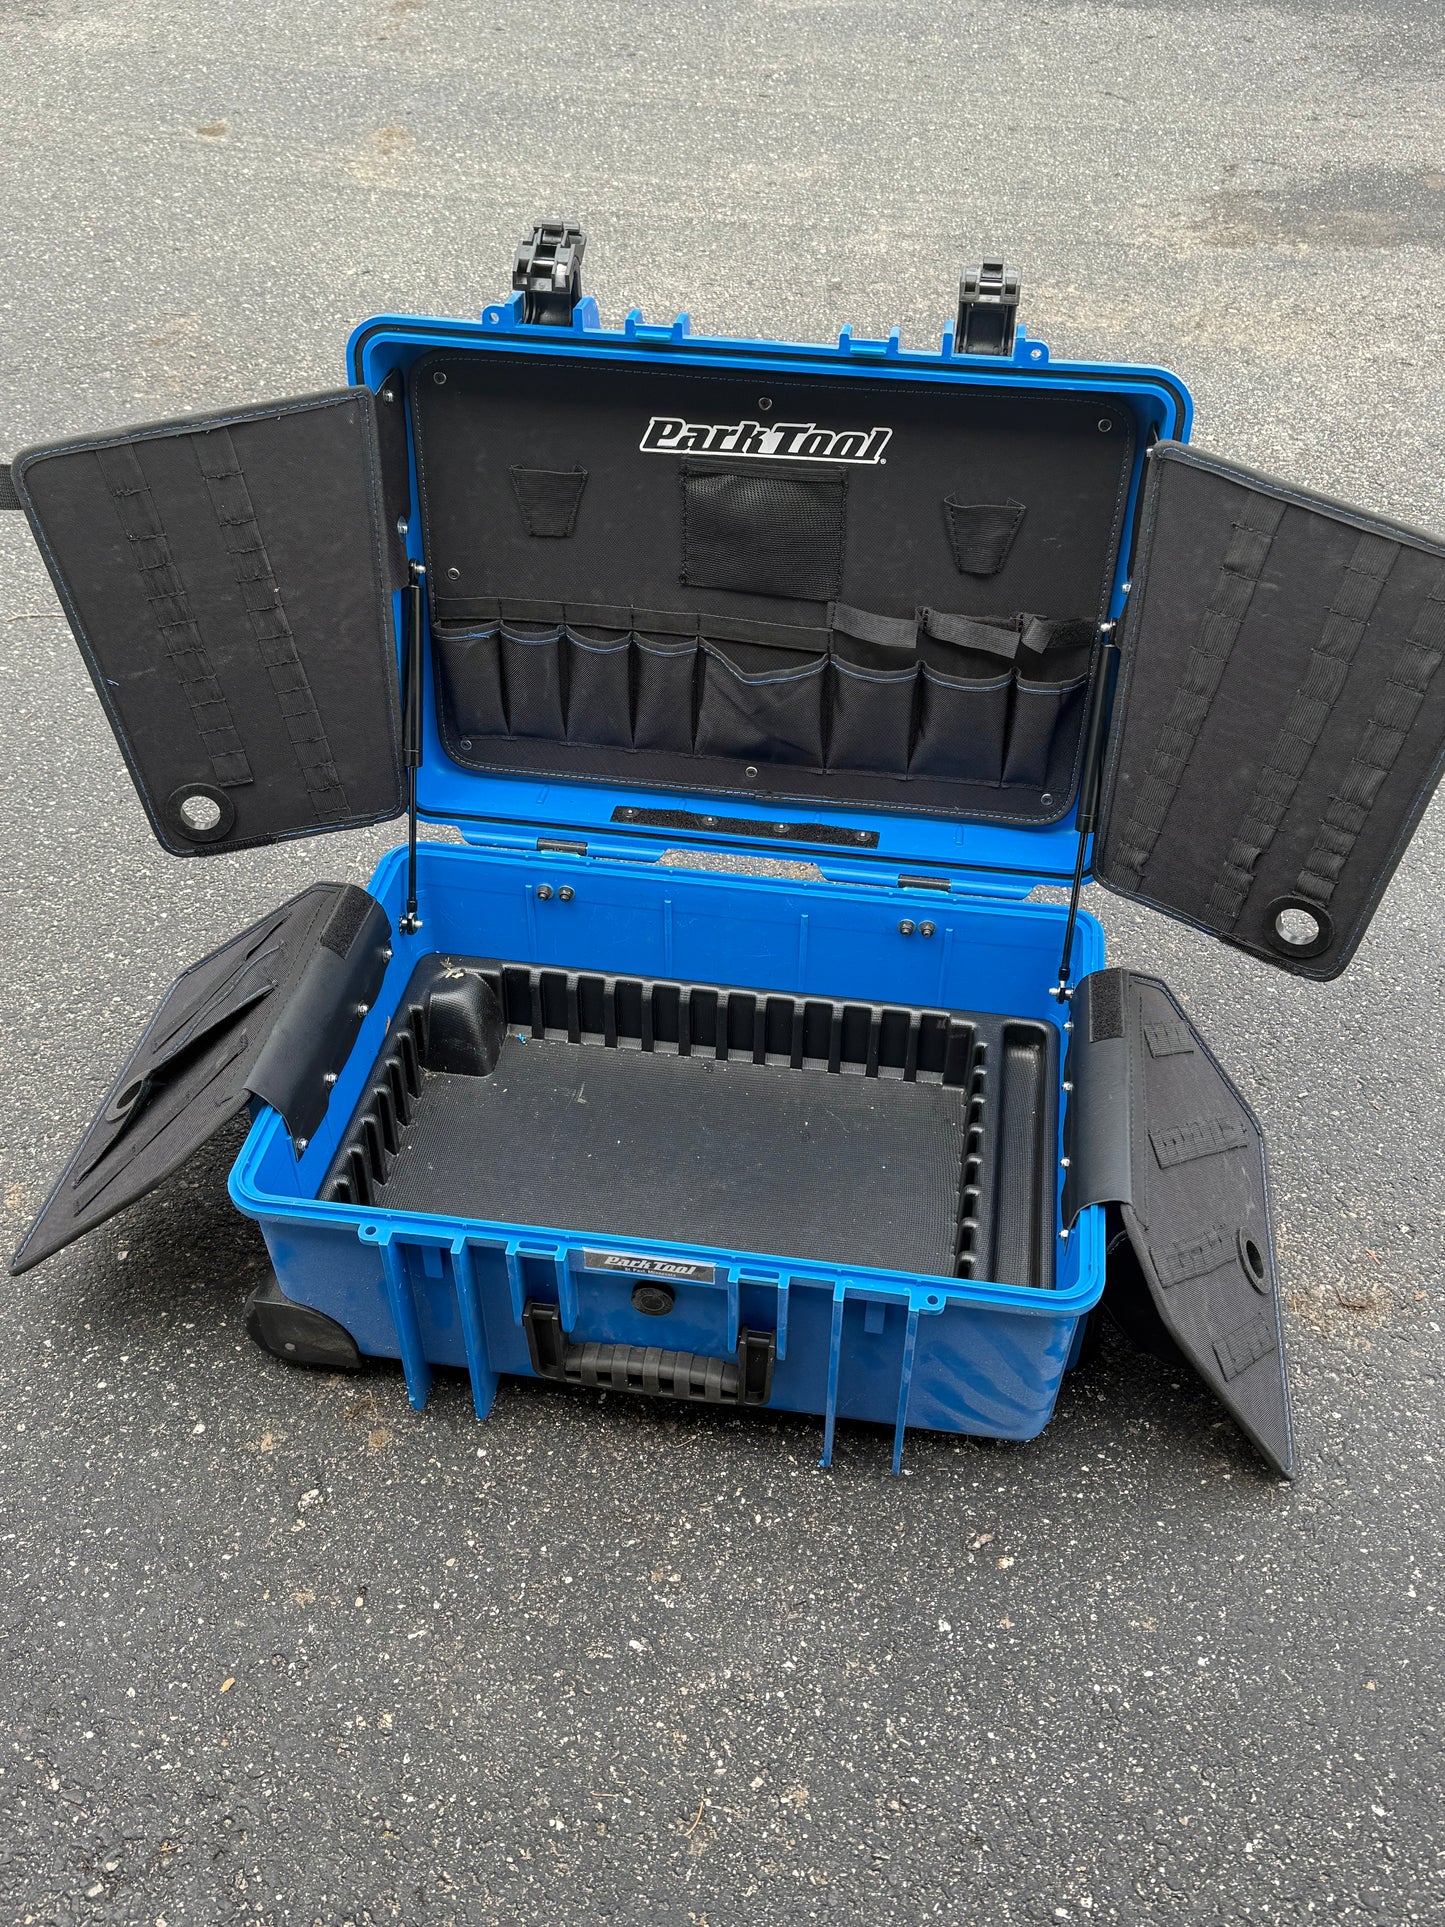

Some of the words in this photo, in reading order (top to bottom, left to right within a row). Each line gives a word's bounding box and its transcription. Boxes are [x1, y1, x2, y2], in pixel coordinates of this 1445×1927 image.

[640, 417, 771, 455] Park
[604, 1256, 651, 1269] Park
[652, 1261, 697, 1275] Tool
